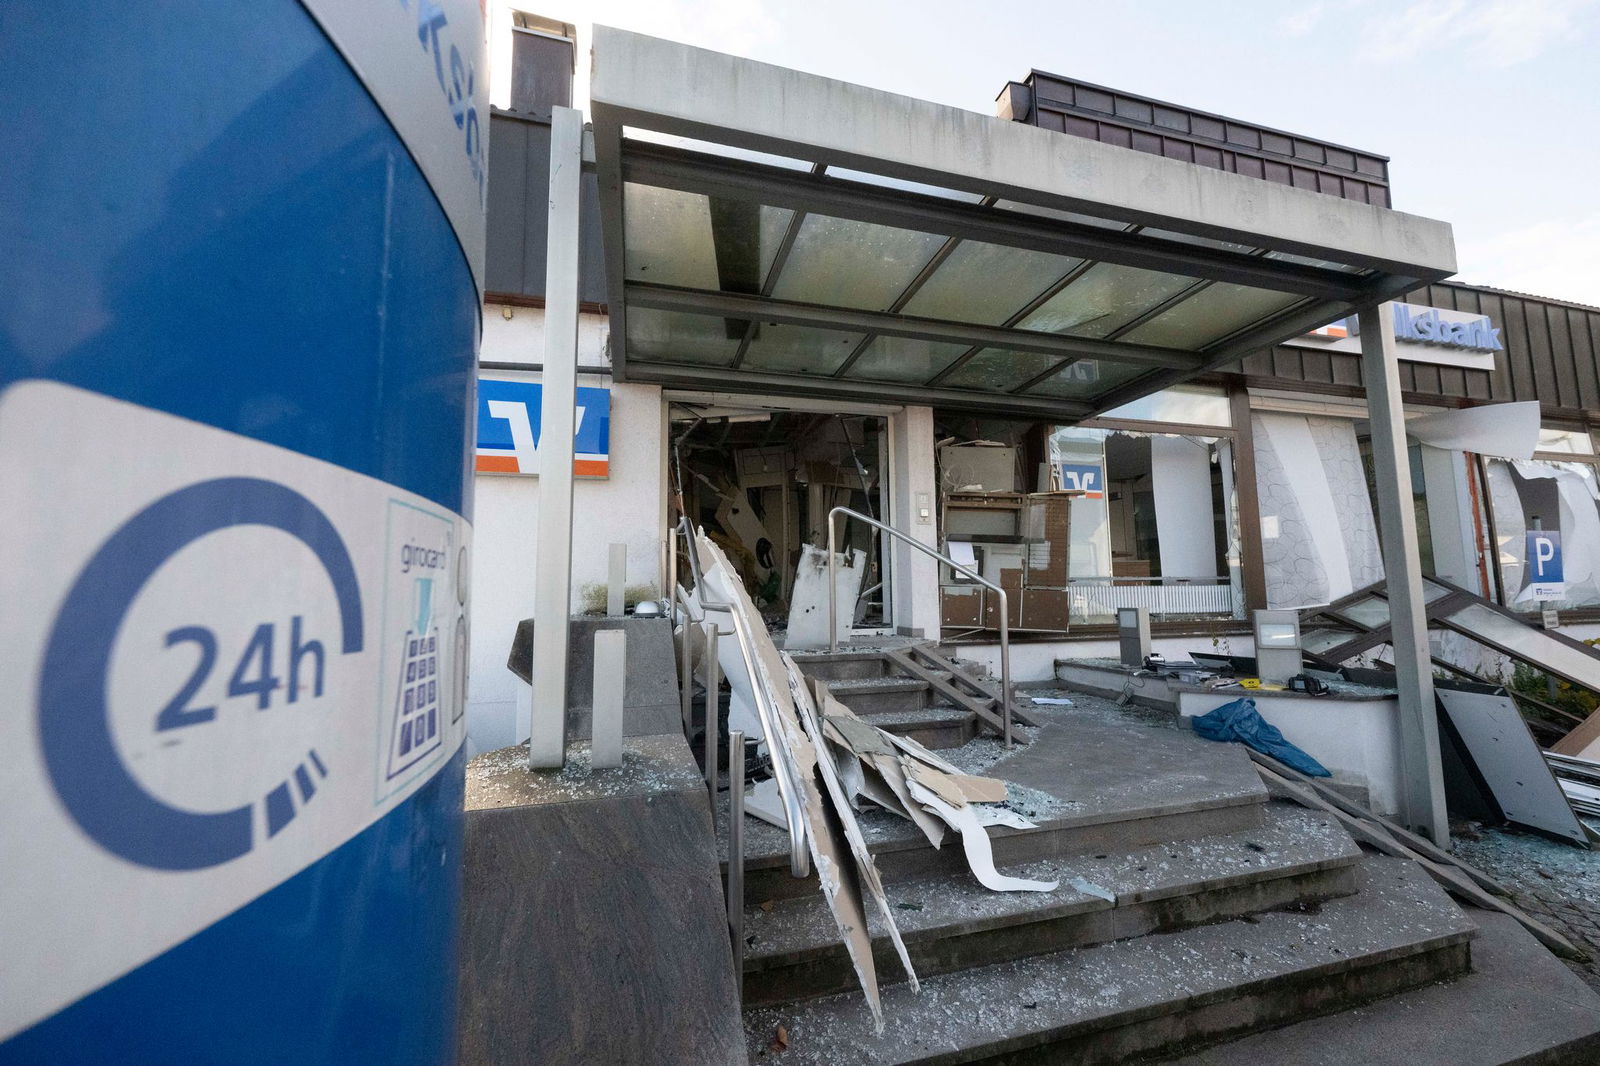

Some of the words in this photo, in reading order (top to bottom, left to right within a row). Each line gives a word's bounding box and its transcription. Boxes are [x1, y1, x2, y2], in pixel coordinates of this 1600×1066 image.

[1393, 303, 1504, 351] lksbank
[1535, 537, 1554, 577] P
[154, 615, 325, 733] 24h
